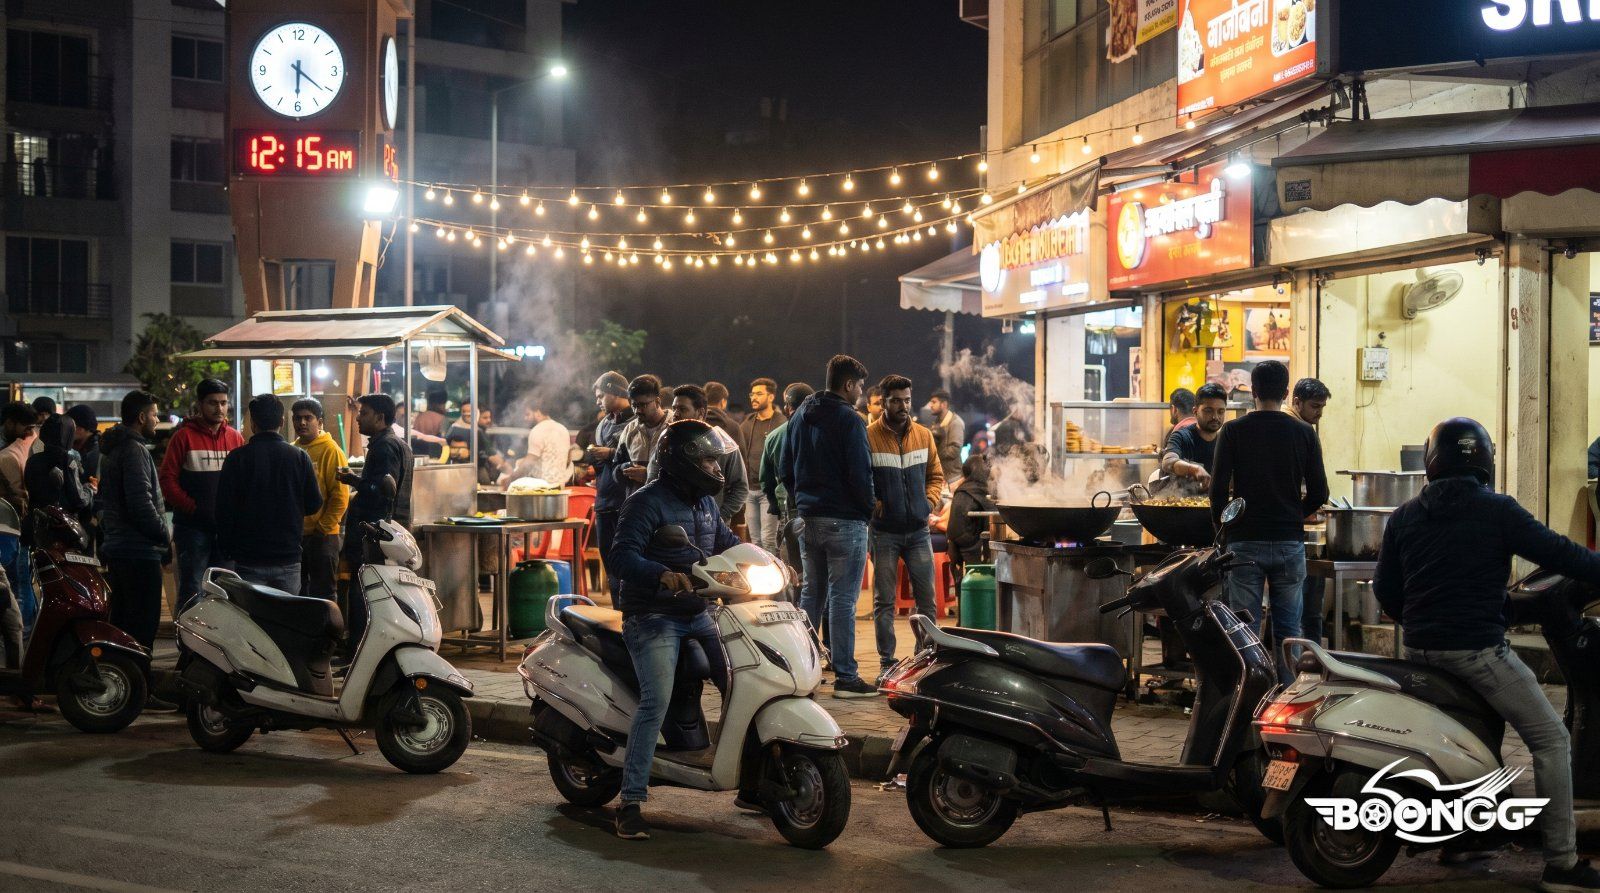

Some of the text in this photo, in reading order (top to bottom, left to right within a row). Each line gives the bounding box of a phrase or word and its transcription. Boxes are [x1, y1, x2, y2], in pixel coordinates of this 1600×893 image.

[292, 29, 305, 41] 12
[259, 65, 267, 76] 9
[330, 65, 338, 77] 3
[294, 101, 302, 112] 6
[251, 135, 353, 170] 12:15 AM
